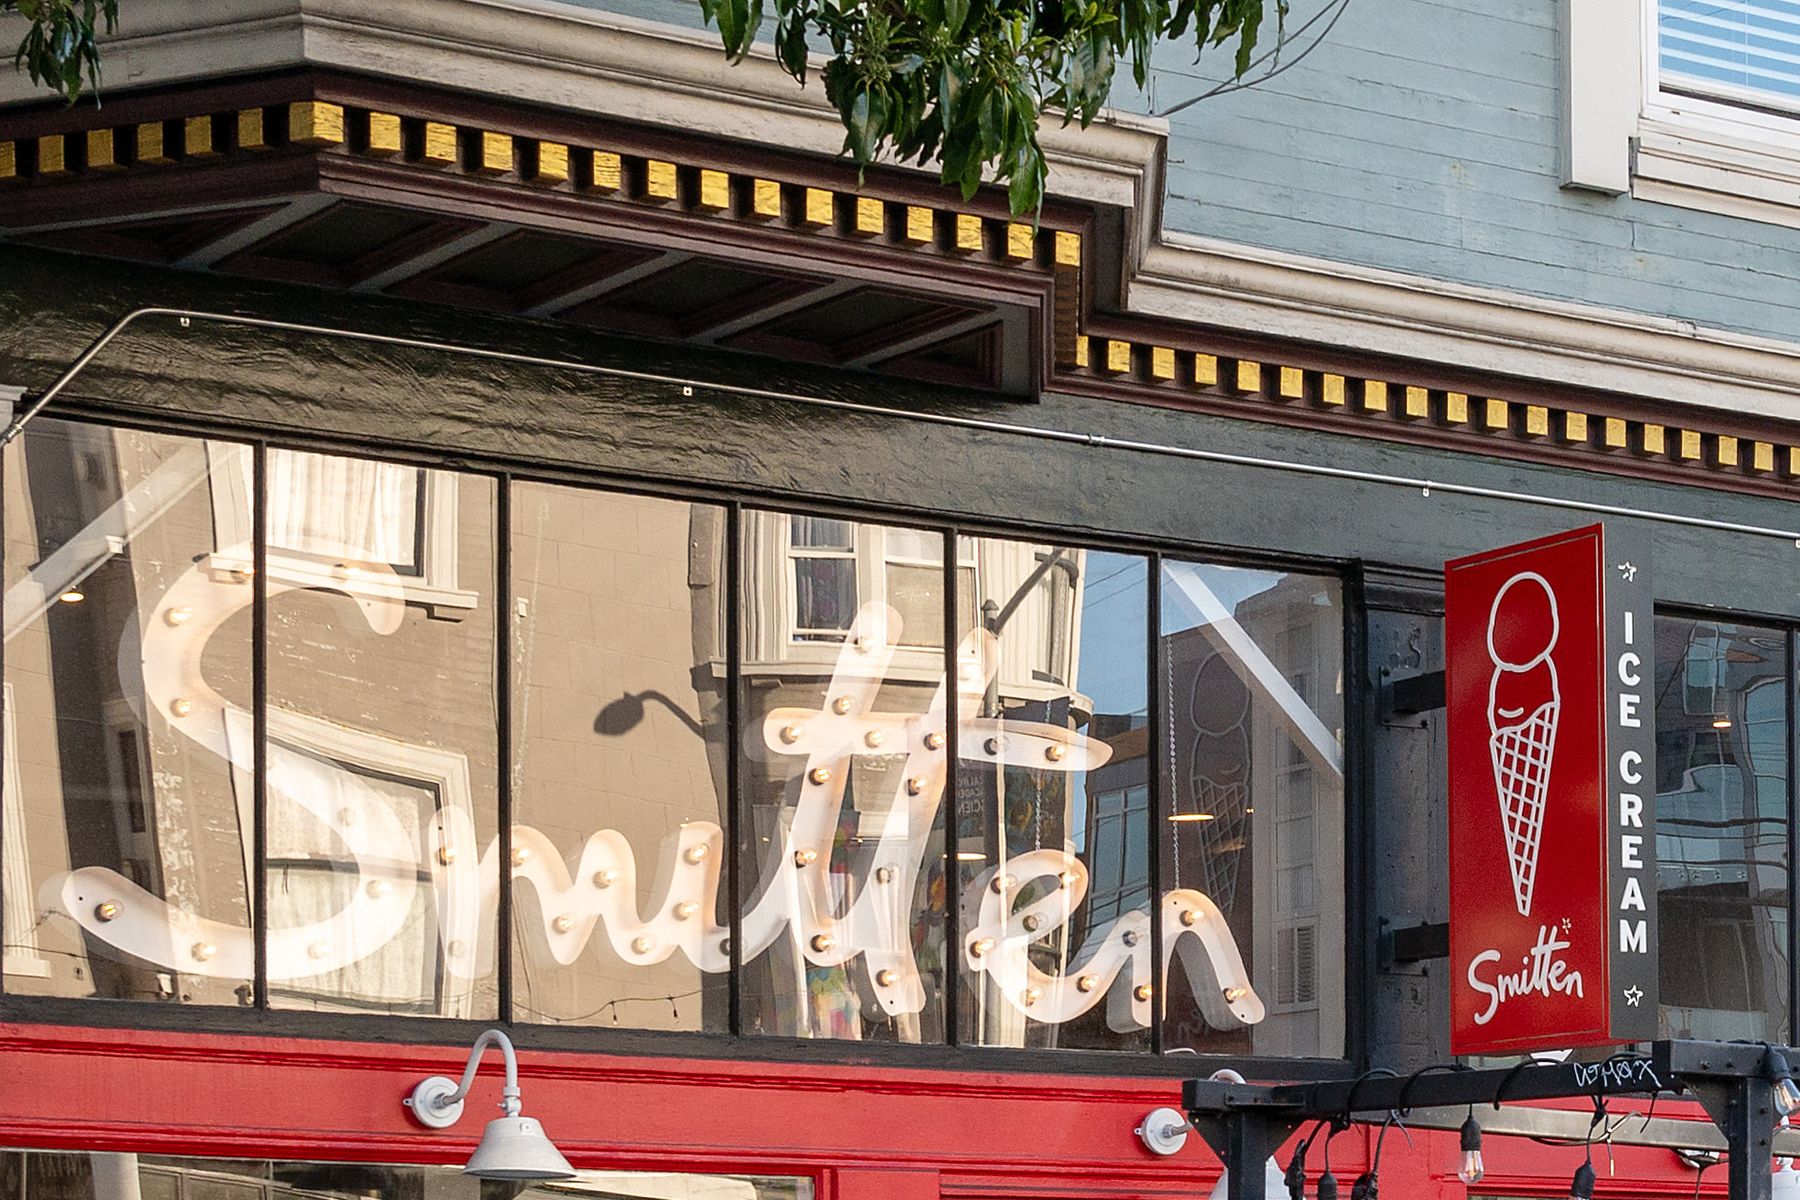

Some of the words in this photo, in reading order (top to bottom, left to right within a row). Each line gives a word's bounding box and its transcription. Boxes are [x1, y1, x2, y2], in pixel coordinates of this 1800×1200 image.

[1618, 611, 1642, 729] ICE
[62, 541, 1265, 1030] Smitten
[1618, 750, 1648, 955] CREAM
[1467, 924, 1585, 1026] Smitten
